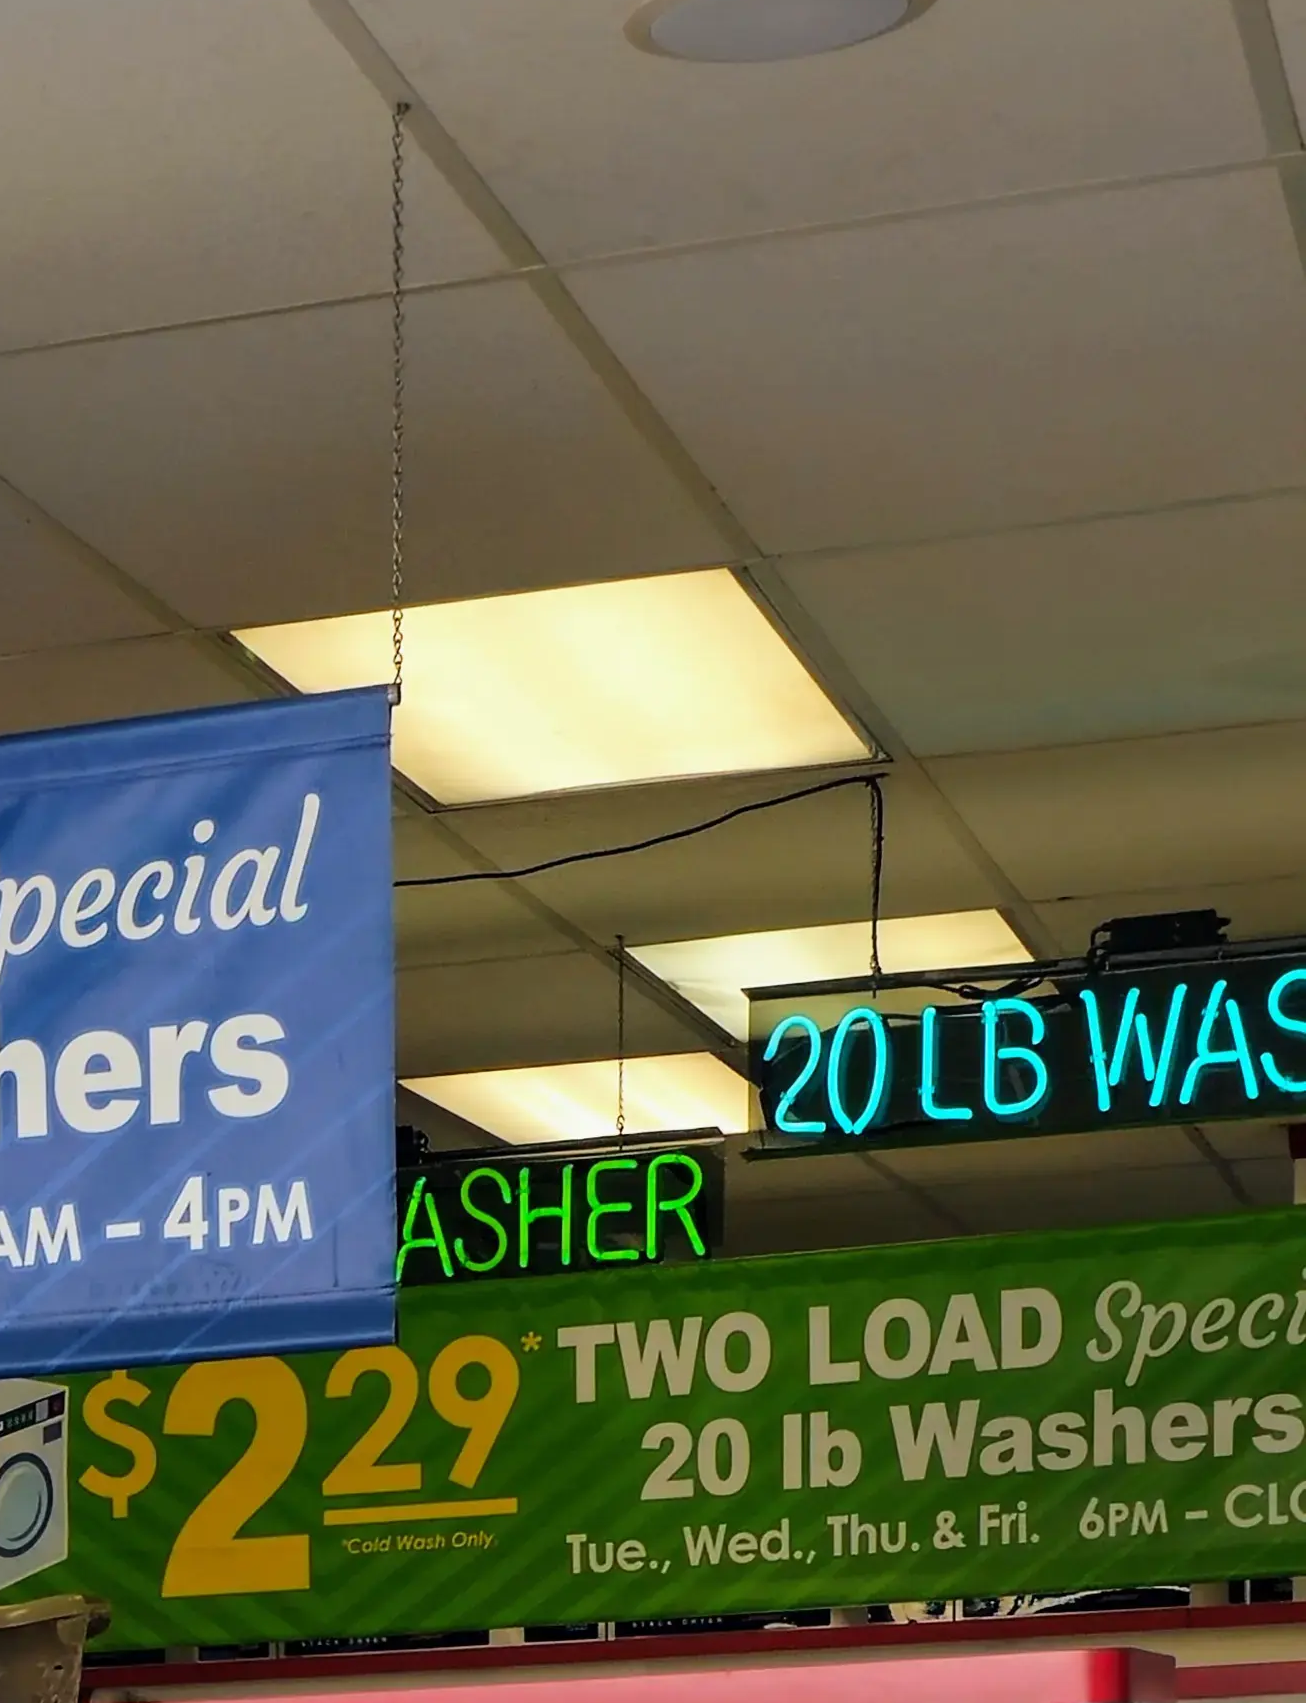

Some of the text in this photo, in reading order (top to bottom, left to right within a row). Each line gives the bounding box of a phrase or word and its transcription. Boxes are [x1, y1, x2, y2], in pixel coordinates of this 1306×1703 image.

[763, 968, 1306, 1135] 20 LB WAS
[164, 1174, 311, 1254] 4PM
[396, 1153, 705, 1284] ASHER
[557, 1267, 1306, 1405] TWO LOAD Speci
[641, 1389, 1305, 1502] 20 lb Washers
[397, 1533, 445, 1551] Wash
[566, 1534, 671, 1574] Tue.,
[684, 1518, 816, 1566] Wed.,
[827, 1513, 920, 1556] Thu.
[933, 1510, 966, 1549] &
[979, 1501, 1040, 1546] Fri.
[1079, 1498, 1168, 1539] 6PM
